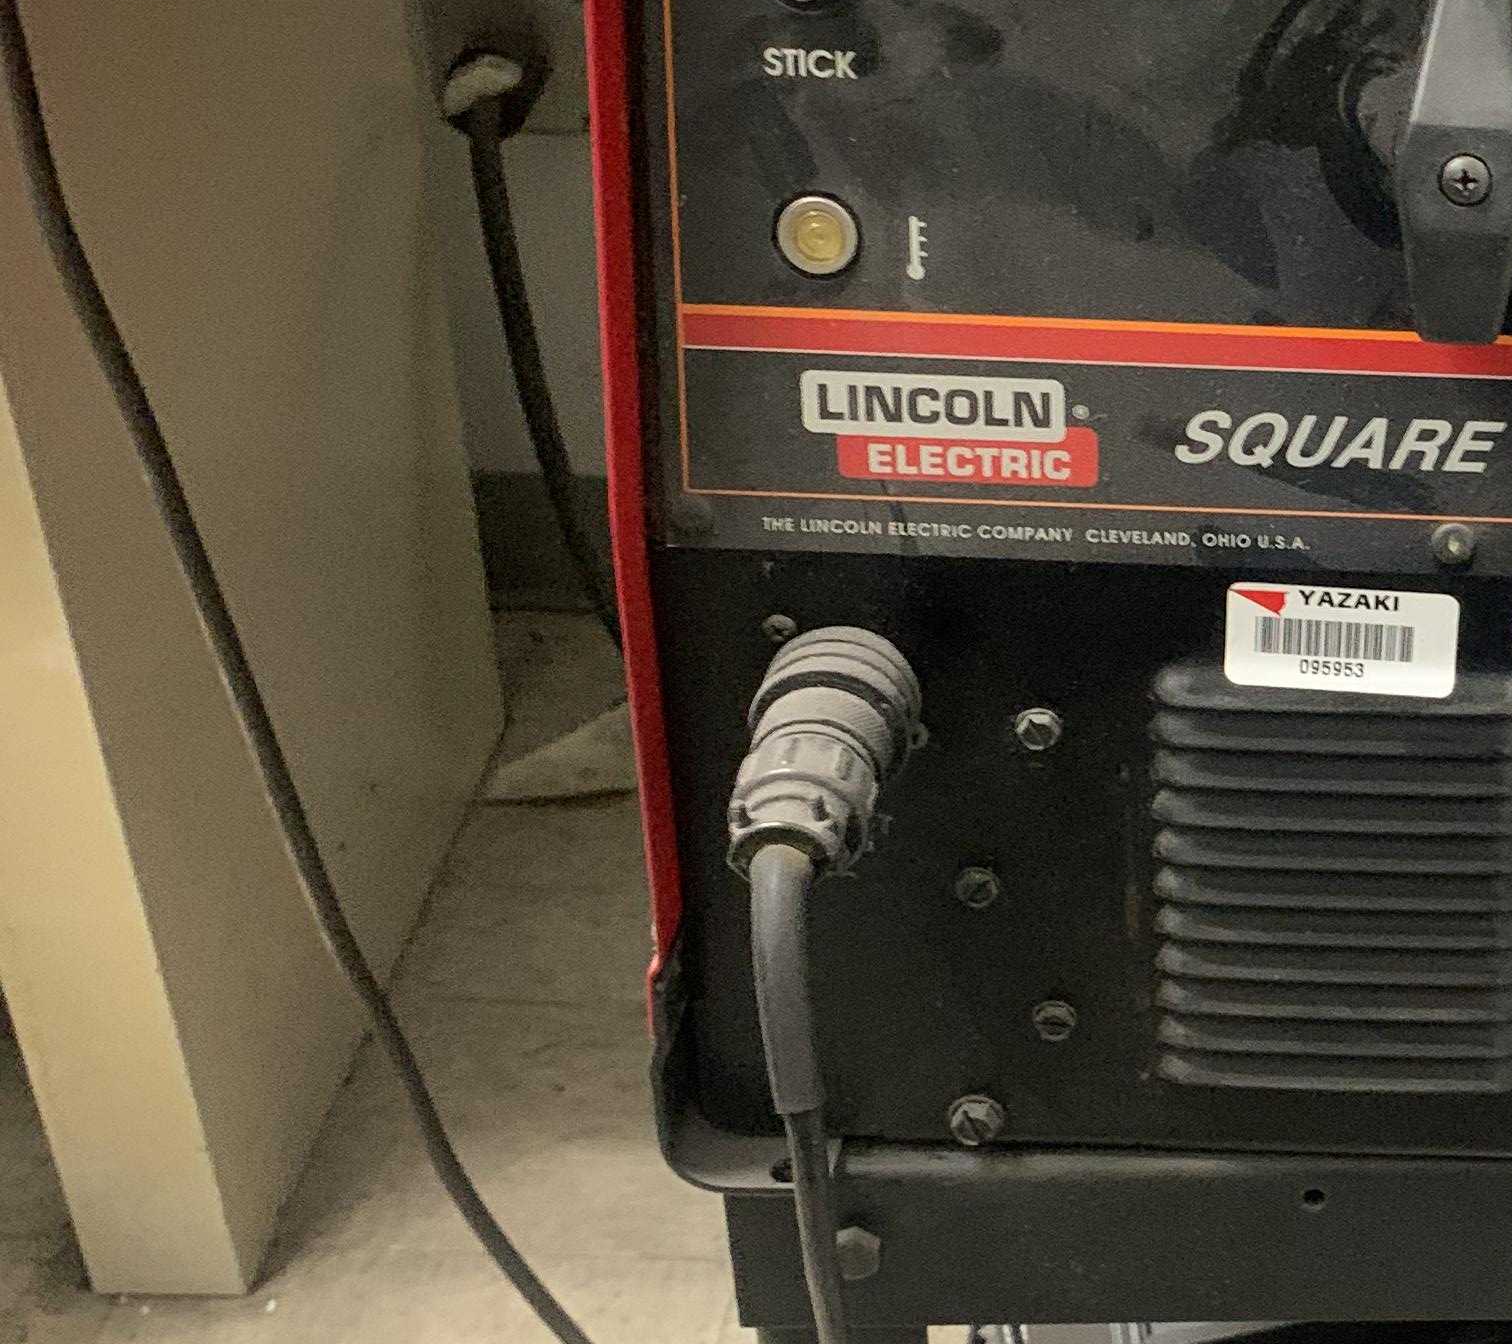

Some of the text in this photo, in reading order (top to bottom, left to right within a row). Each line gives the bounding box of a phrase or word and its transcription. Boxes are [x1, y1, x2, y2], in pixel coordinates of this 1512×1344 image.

[764, 47, 857, 79] STICK
[816, 381, 1052, 429] LINCOLN
[1175, 410, 1507, 472] SQUARE
[868, 440, 1071, 480] ELECTRIC
[762, 517, 795, 531] THE
[800, 519, 882, 535] LINCOLN
[888, 522, 972, 538] ELECTRIC
[977, 525, 1072, 541] COMPANY
[1202, 533, 1251, 547] OHIO
[1258, 535, 1310, 550] U.S.A.
[1299, 589, 1400, 612] YAZAKI
[1299, 659, 1365, 679] 095953
